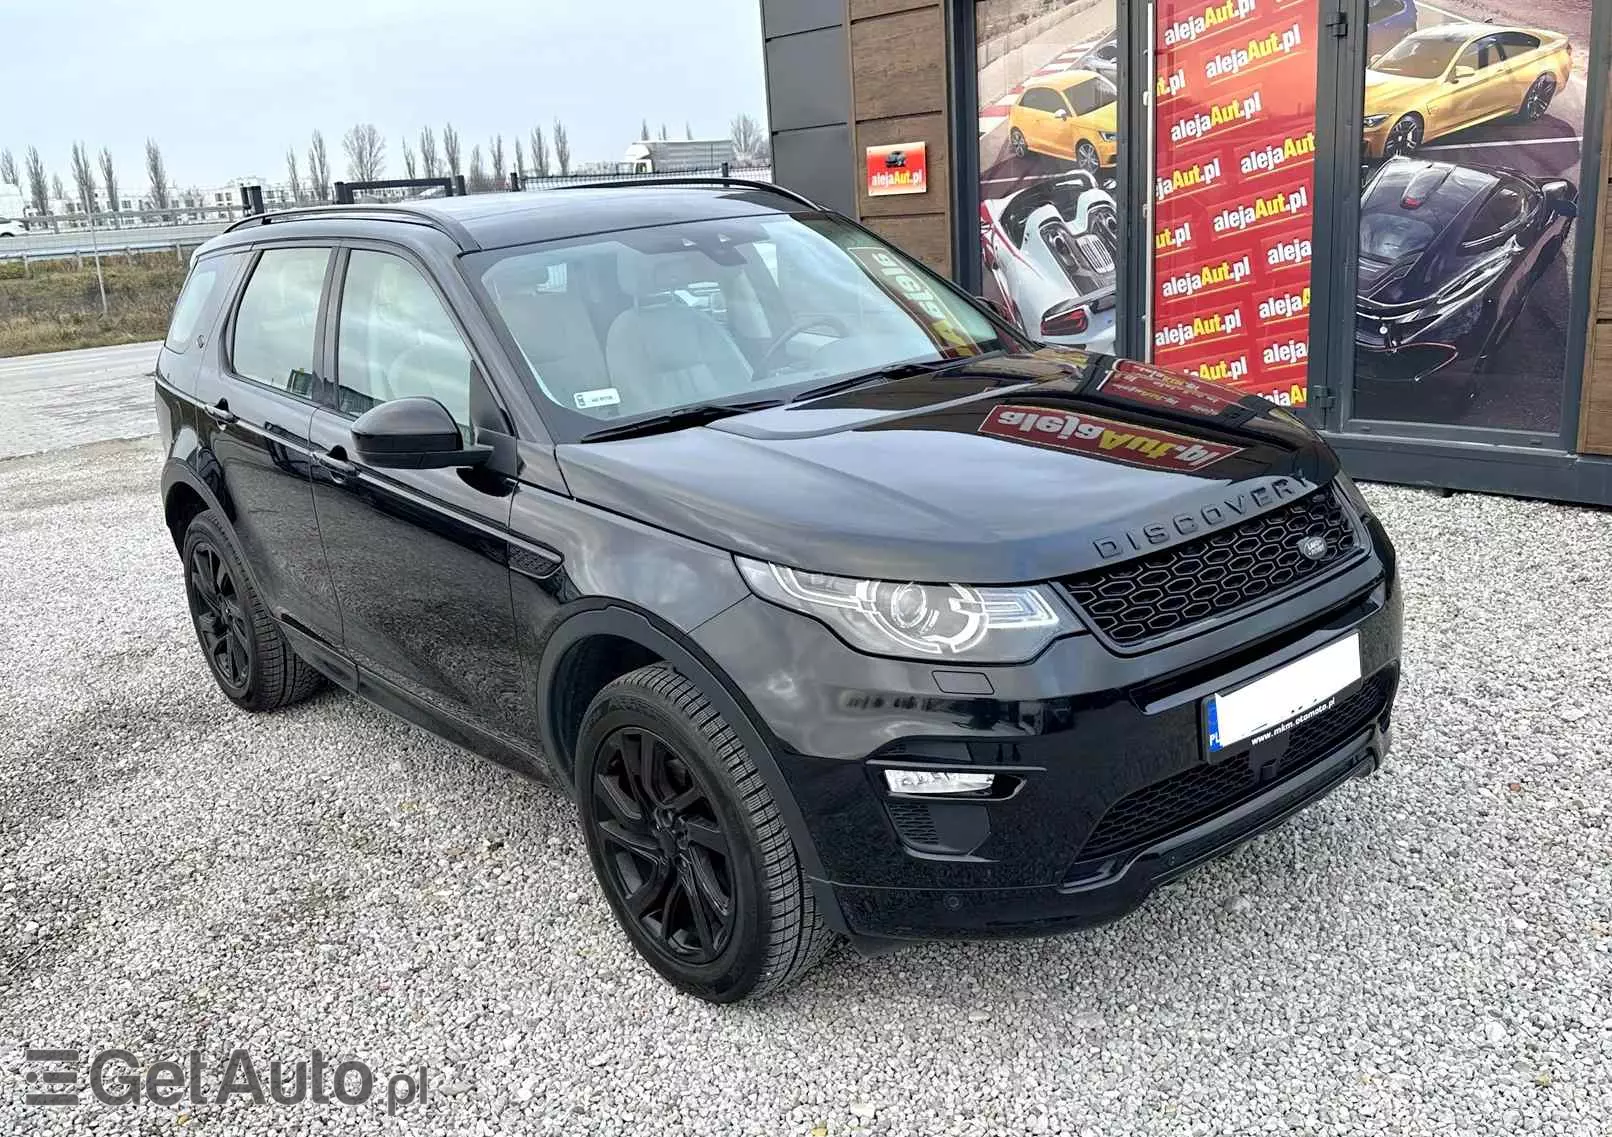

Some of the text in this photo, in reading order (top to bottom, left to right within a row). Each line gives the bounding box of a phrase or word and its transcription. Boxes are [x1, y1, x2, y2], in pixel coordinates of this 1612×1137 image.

[1164, 0, 1256, 46] alejaAut.pl
[1205, 23, 1302, 79] alejaAut.pl
[1171, 91, 1262, 142] alejaAut.pl
[871, 168, 923, 188] alejaAut.pl
[1156, 157, 1220, 200] jaAut.pl
[1213, 185, 1308, 232] alejaAut.pl
[1267, 238, 1312, 266] aleja
[1162, 256, 1251, 298] alejaAut.pl
[1155, 308, 1242, 346] alejaAut.pl
[1251, 696, 1336, 746] www.mkm.otomoto.pl
